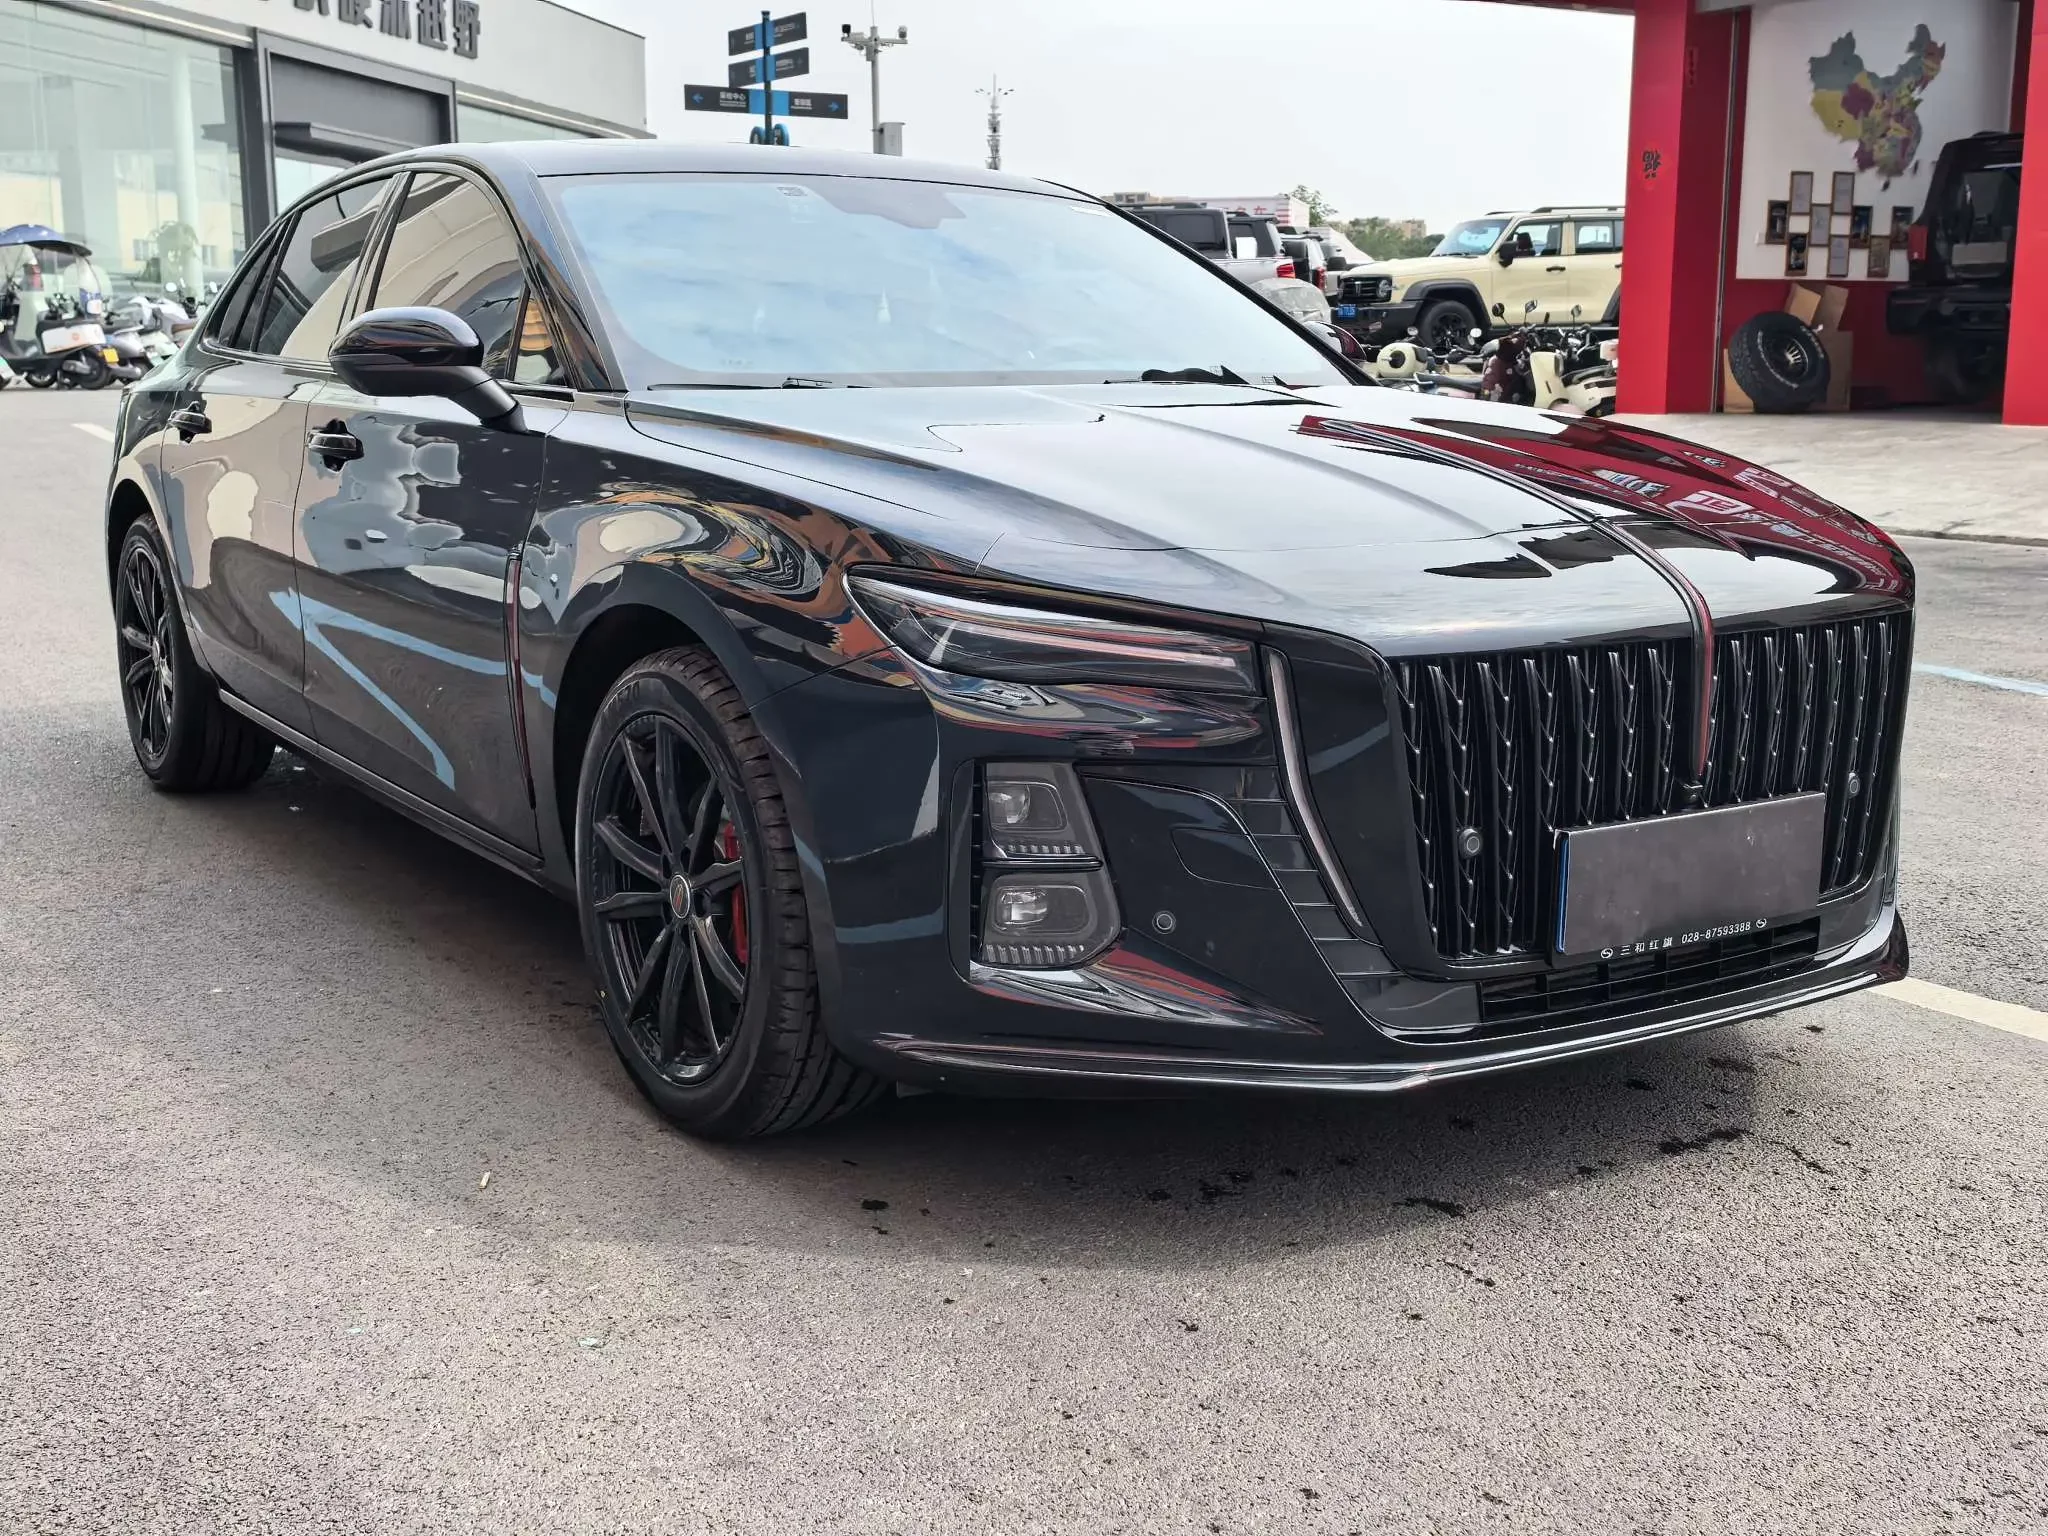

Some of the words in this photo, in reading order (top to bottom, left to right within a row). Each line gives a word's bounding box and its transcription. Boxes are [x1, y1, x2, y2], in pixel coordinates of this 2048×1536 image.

[1620, 937, 1673, 956] 三和红旗
[1681, 922, 1751, 944] 028-87593388
